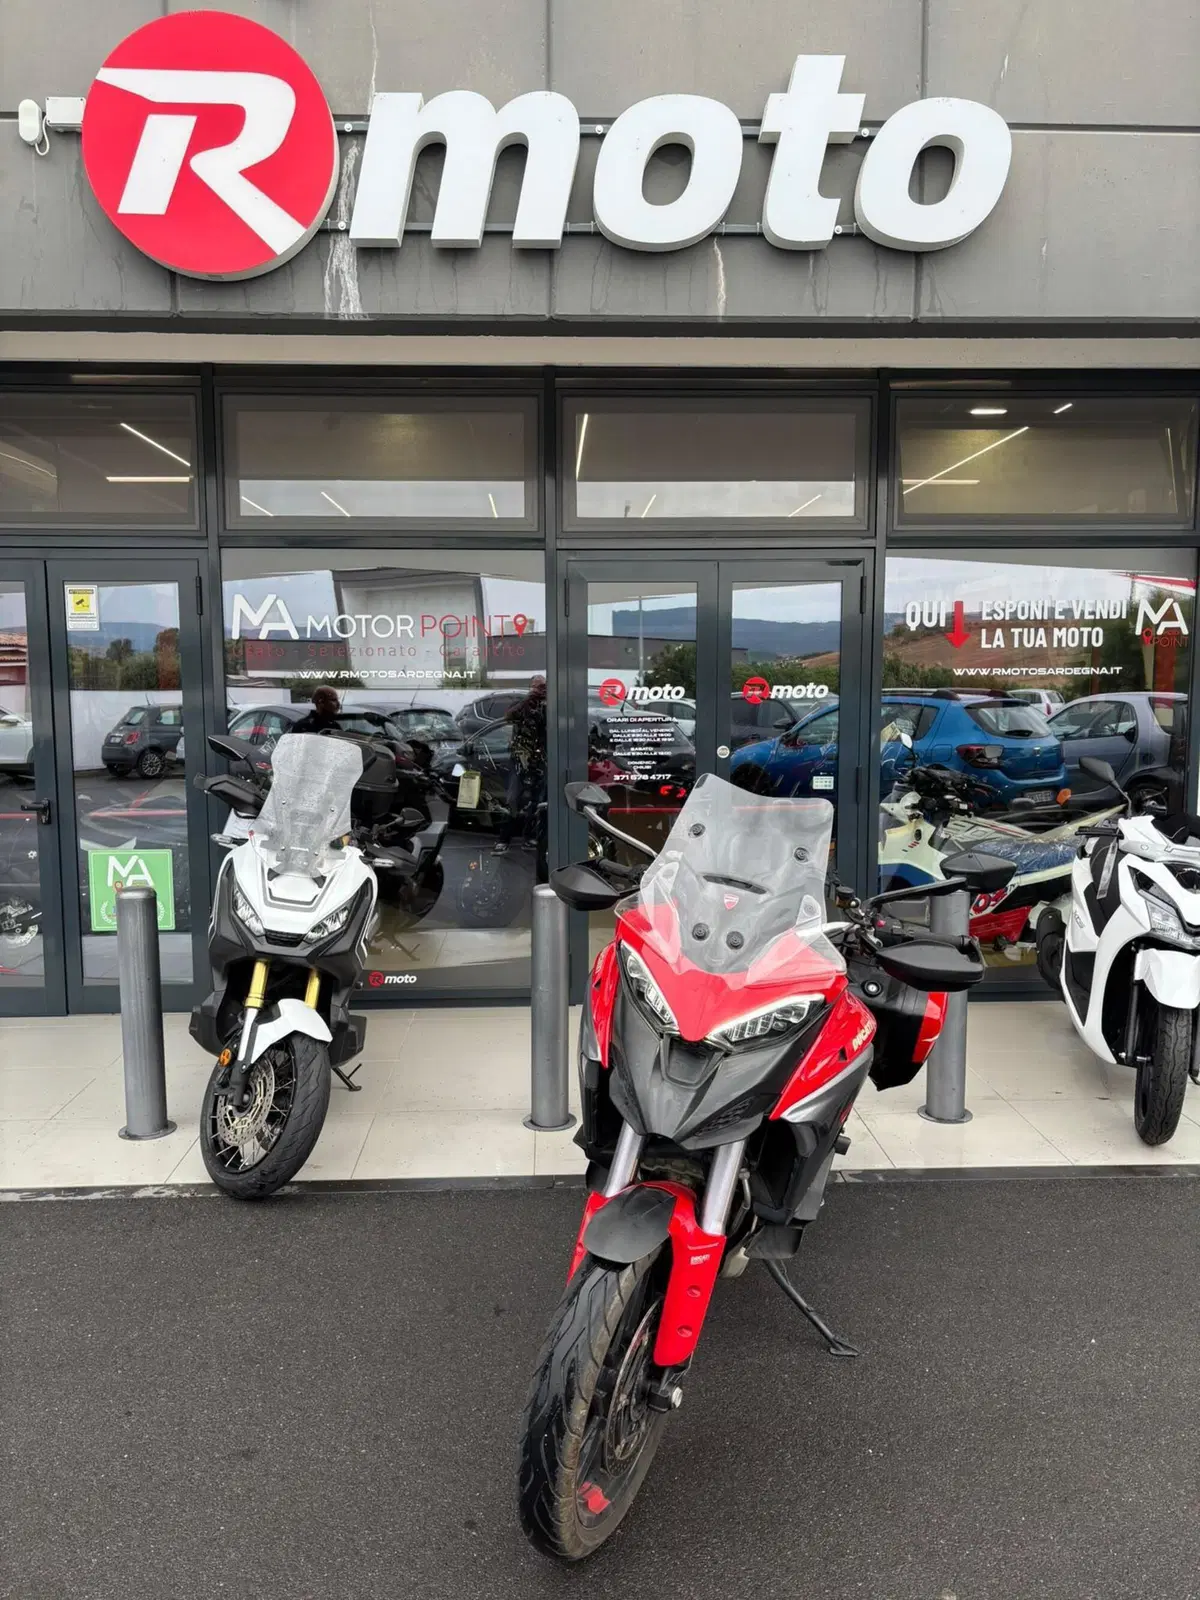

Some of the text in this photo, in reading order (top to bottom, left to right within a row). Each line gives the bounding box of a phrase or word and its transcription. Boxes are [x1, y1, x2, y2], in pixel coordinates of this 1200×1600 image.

[349, 54, 1012, 252] moto
[905, 600, 946, 631] QUI
[981, 599, 1128, 620] ESPONI E VENDI
[306, 614, 510, 639] MOTOR POINT
[981, 627, 1104, 648] LA TUA MOTO
[1151, 636, 1189, 648] POINT
[232, 643, 285, 657] Usato
[308, 643, 417, 657] Selezionato
[299, 670, 476, 679] WWW.RMOTOSARDEGNA.IT
[952, 666, 1123, 676] WWW.RMOTOSARDEGNA.IT
[627, 683, 686, 700] moto
[770, 682, 829, 699] moto
[384, 974, 417, 984] moto
